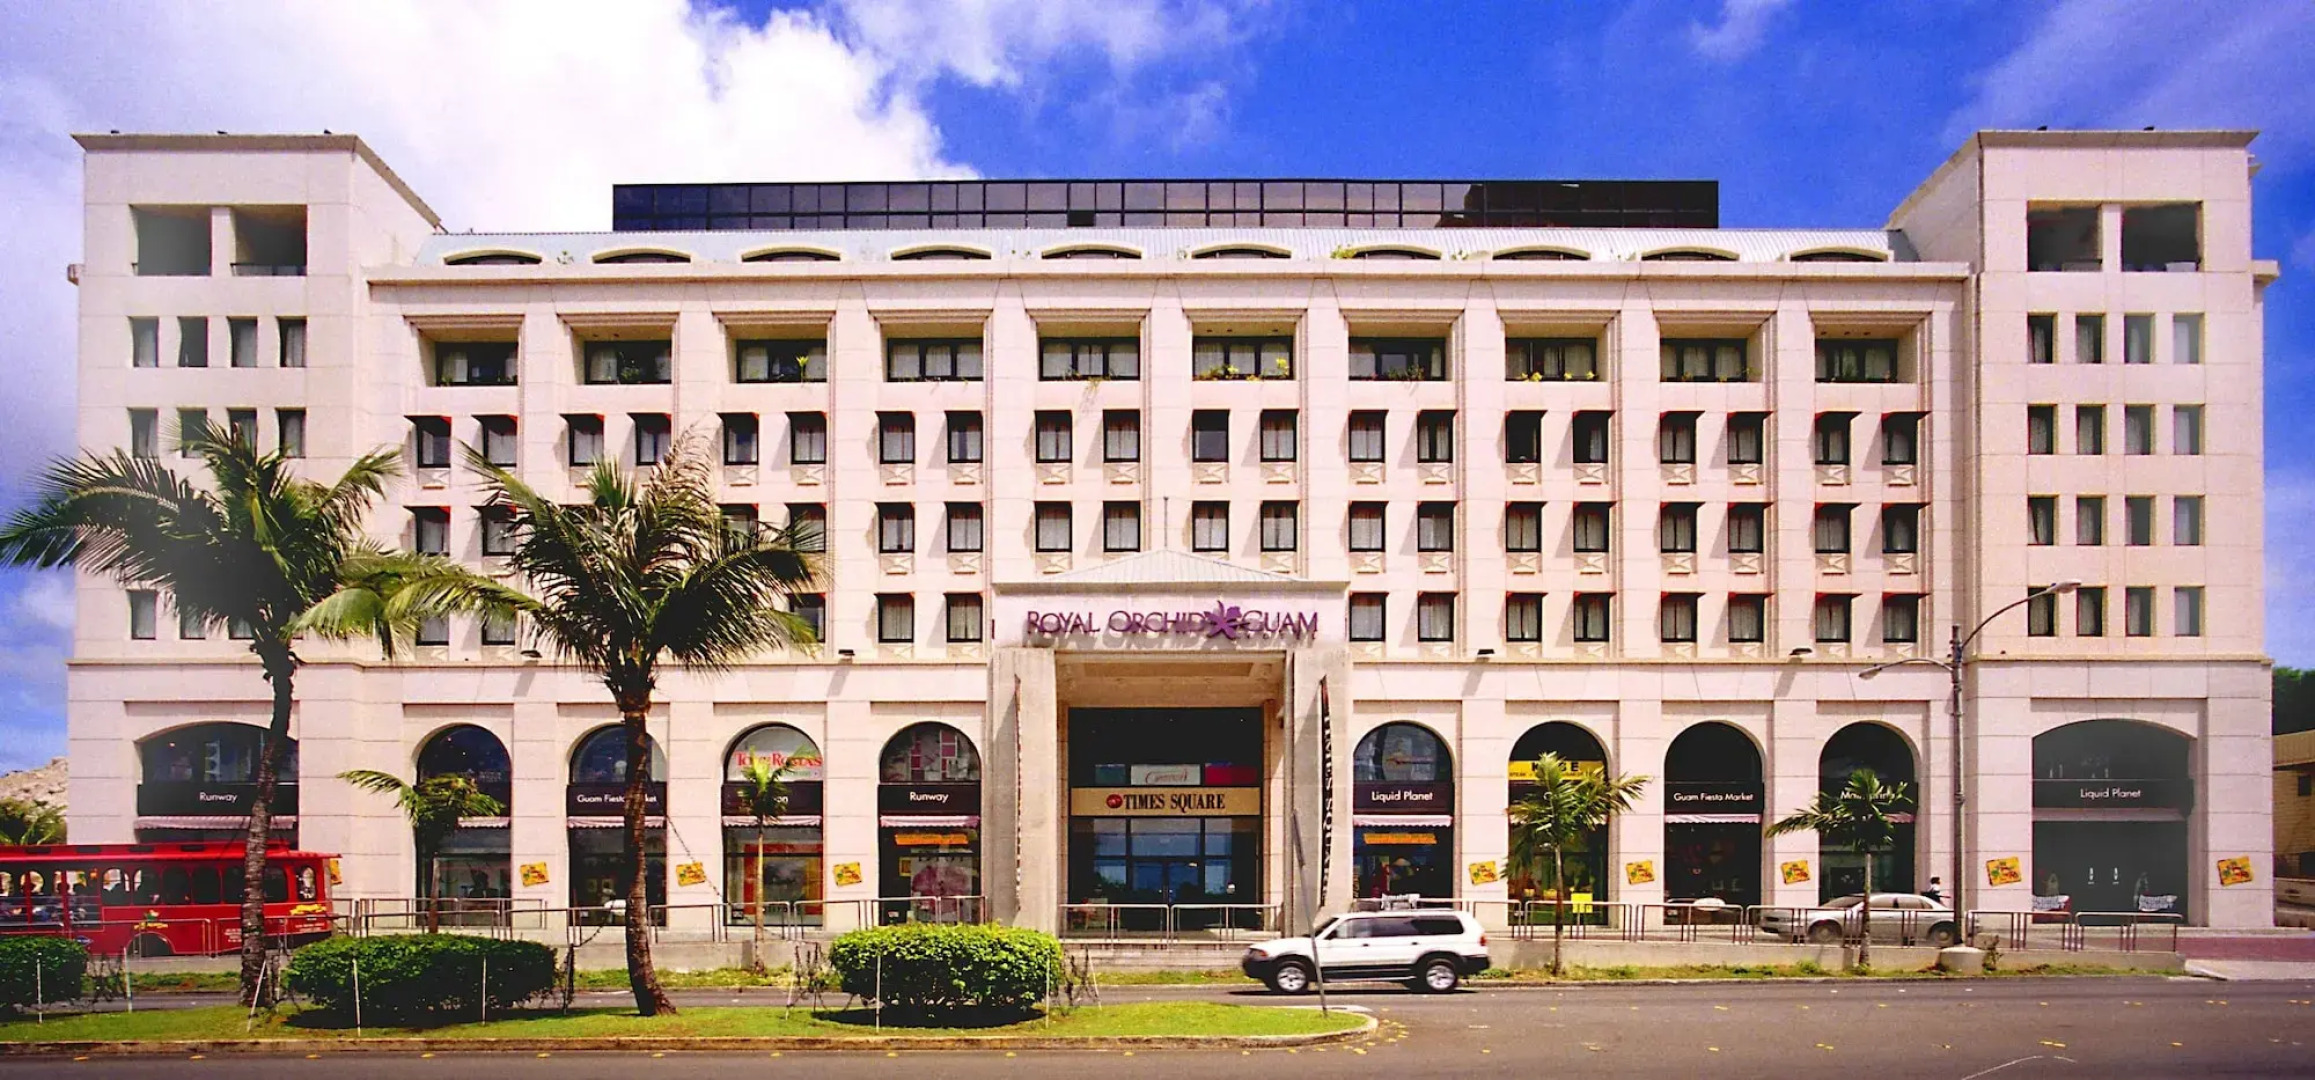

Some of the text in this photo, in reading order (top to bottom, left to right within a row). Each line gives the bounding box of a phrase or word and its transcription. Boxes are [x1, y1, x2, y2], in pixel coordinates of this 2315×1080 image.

[1027, 610, 1318, 634] ROYAL ORCHID GUAM
[1532, 762, 1579, 772] KE
[199, 791, 237, 803] Runway
[576, 794, 602, 803] Guam
[910, 791, 949, 803] Runway
[1372, 790, 1433, 803] Liquid Planet
[1673, 792, 1754, 801] Guam Fiesta Market
[2080, 787, 2141, 800] Liquid Planet
[1123, 793, 1226, 813] TIMES SQUARE
